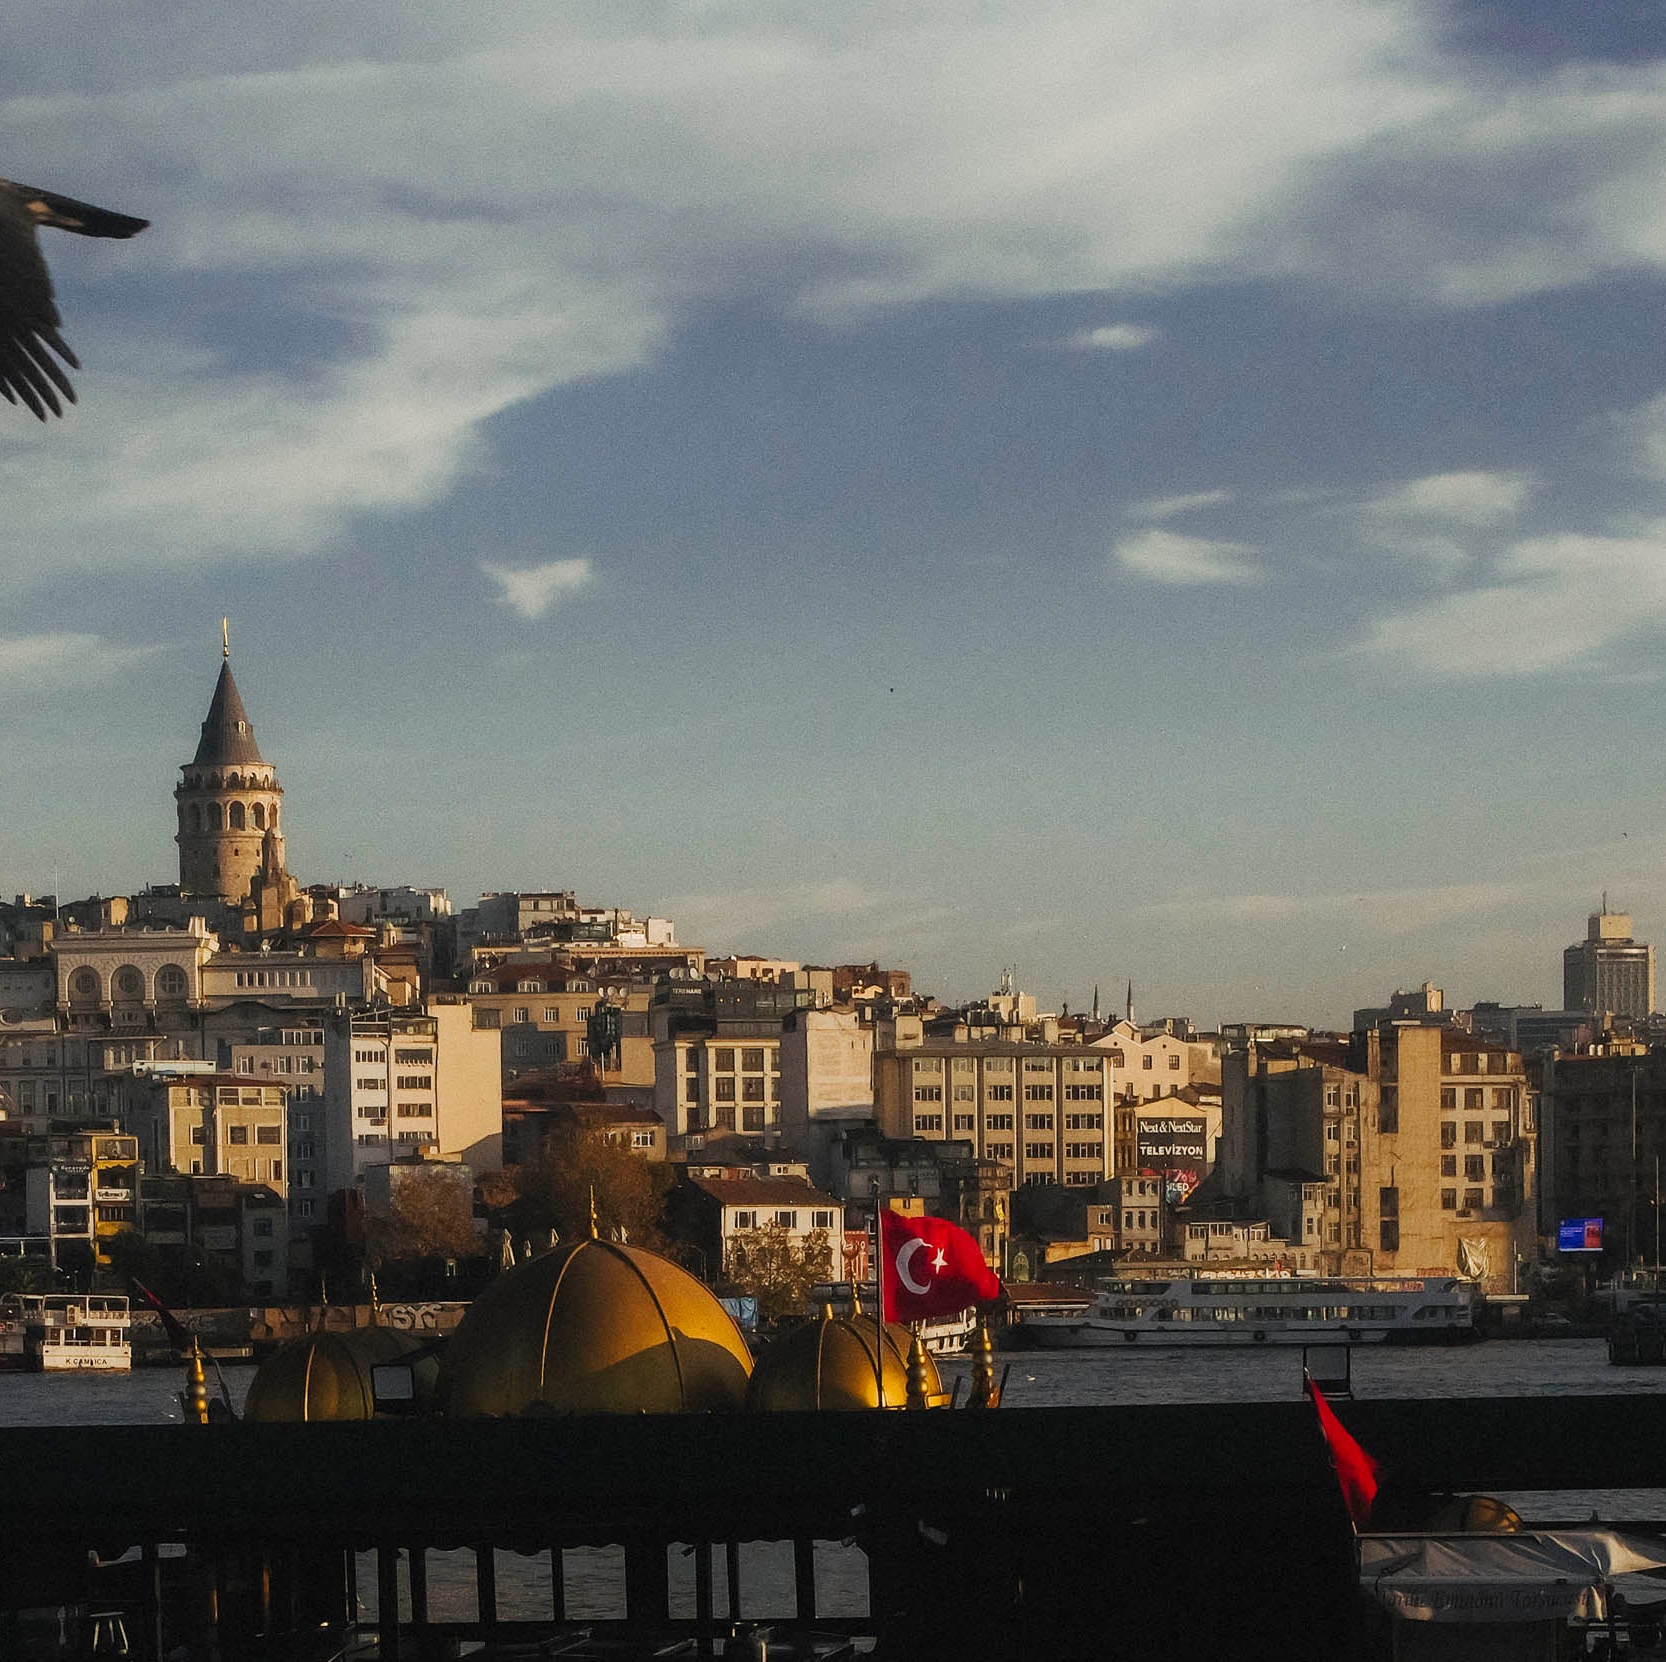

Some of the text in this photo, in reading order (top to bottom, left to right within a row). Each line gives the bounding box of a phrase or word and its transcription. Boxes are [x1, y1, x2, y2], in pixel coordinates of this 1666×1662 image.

[1139, 1120, 1203, 1134] Next & NextStar
[1139, 1143, 1203, 1156] TELEVİZYON
